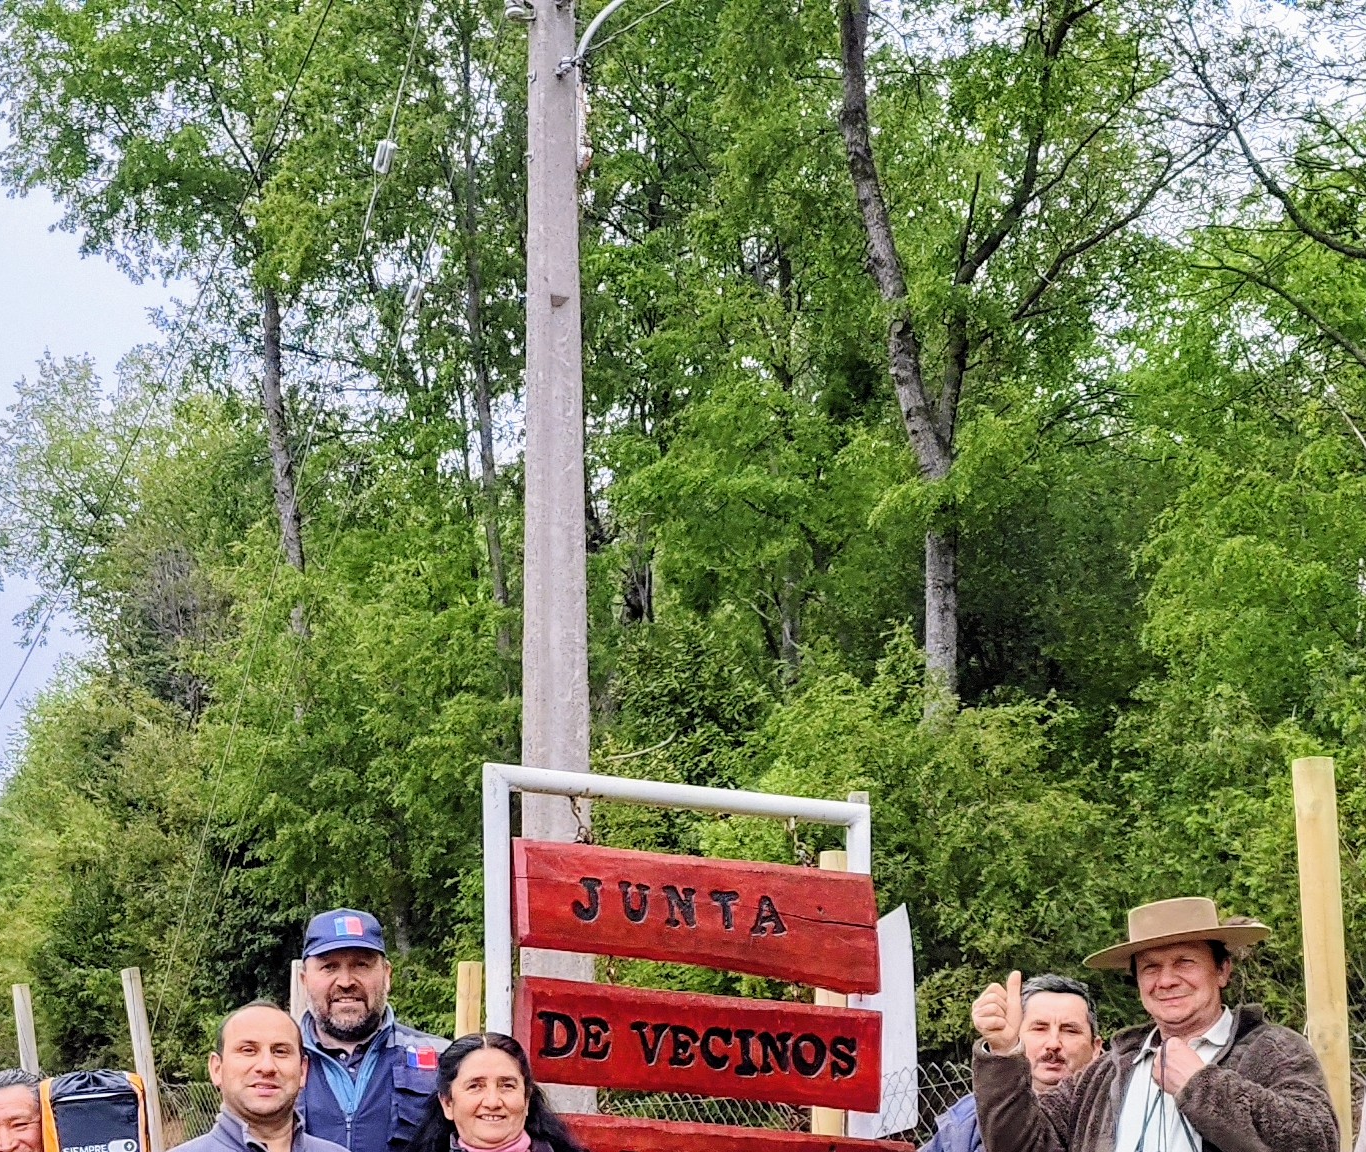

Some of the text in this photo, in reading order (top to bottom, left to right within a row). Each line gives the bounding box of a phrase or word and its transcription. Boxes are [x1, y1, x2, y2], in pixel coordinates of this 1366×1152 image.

[572, 876, 788, 938] JUNTA
[538, 1010, 858, 1081] DE VECINOS
